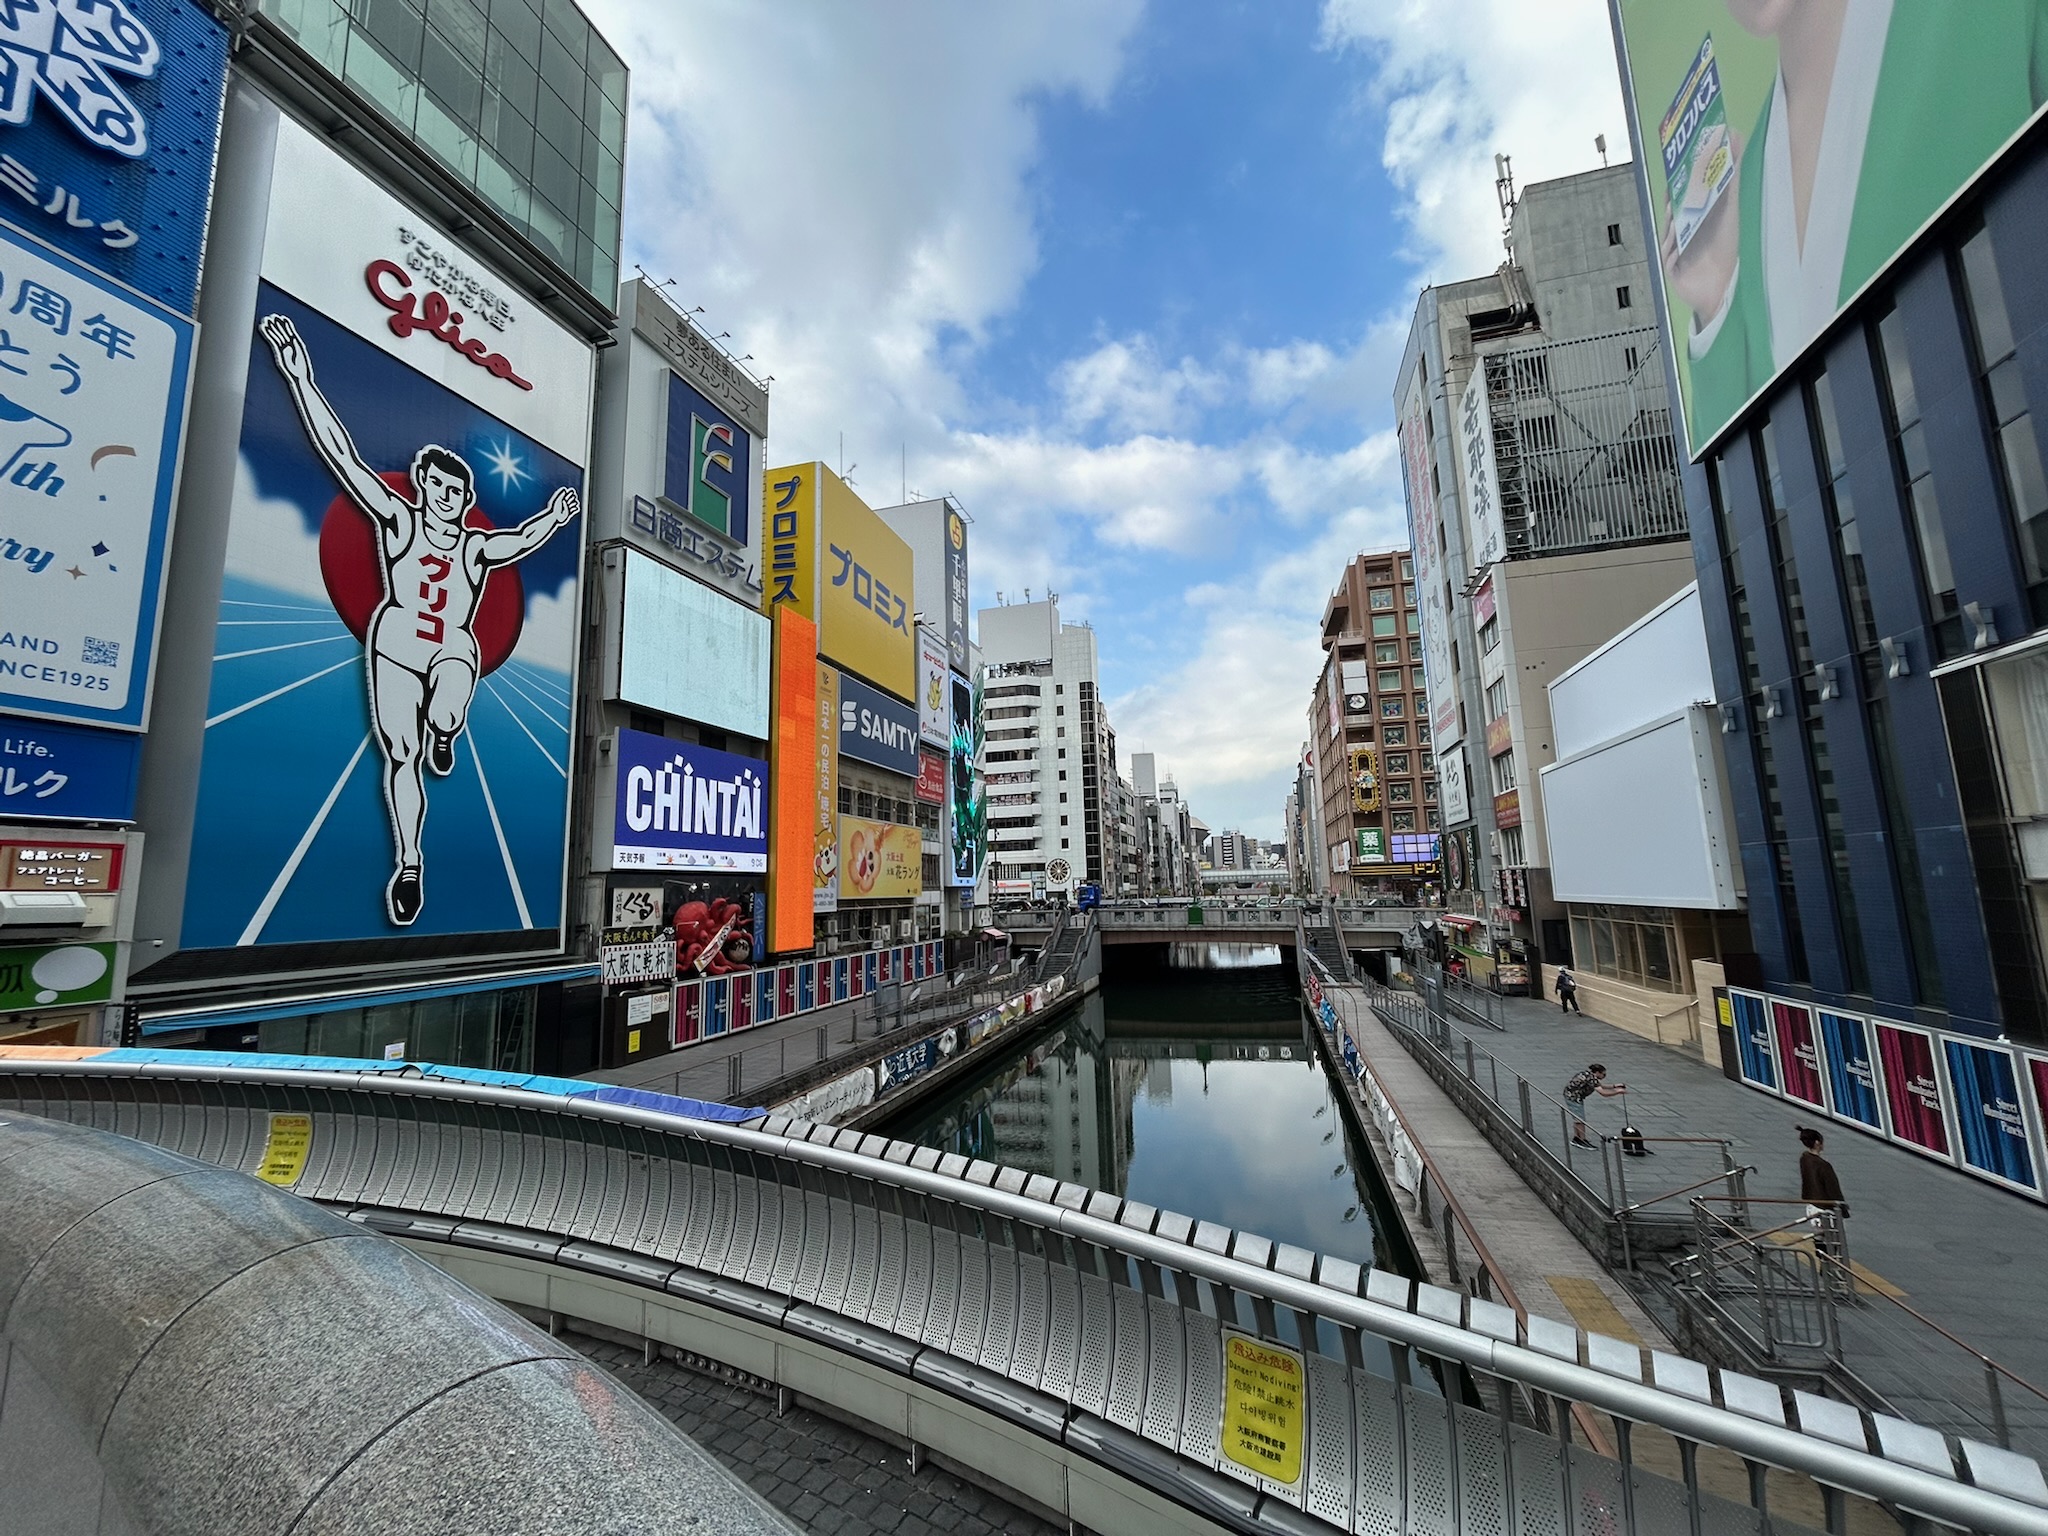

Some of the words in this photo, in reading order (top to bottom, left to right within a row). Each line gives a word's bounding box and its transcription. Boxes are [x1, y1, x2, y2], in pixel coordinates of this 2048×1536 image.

[365, 259, 534, 391] Glico
[662, 332, 752, 418] エステムシリーズ
[676, 318, 742, 387] 夢ある住まい
[633, 494, 764, 594] 日商エステム
[772, 475, 802, 604] プロミス
[416, 553, 454, 645] グリコ
[829, 543, 909, 637] プロミス
[5, 738, 55, 758] Life.
[860, 708, 918, 756] SAMTY
[17, 866, 85, 875] フェアトレード
[20, 850, 103, 862] 絶品バーガー
[619, 852, 645, 863] 天気予報
[45, 876, 99, 885] コーヒー
[623, 892, 654, 921] くくる
[606, 950, 666, 978] 大阪に乾杯
